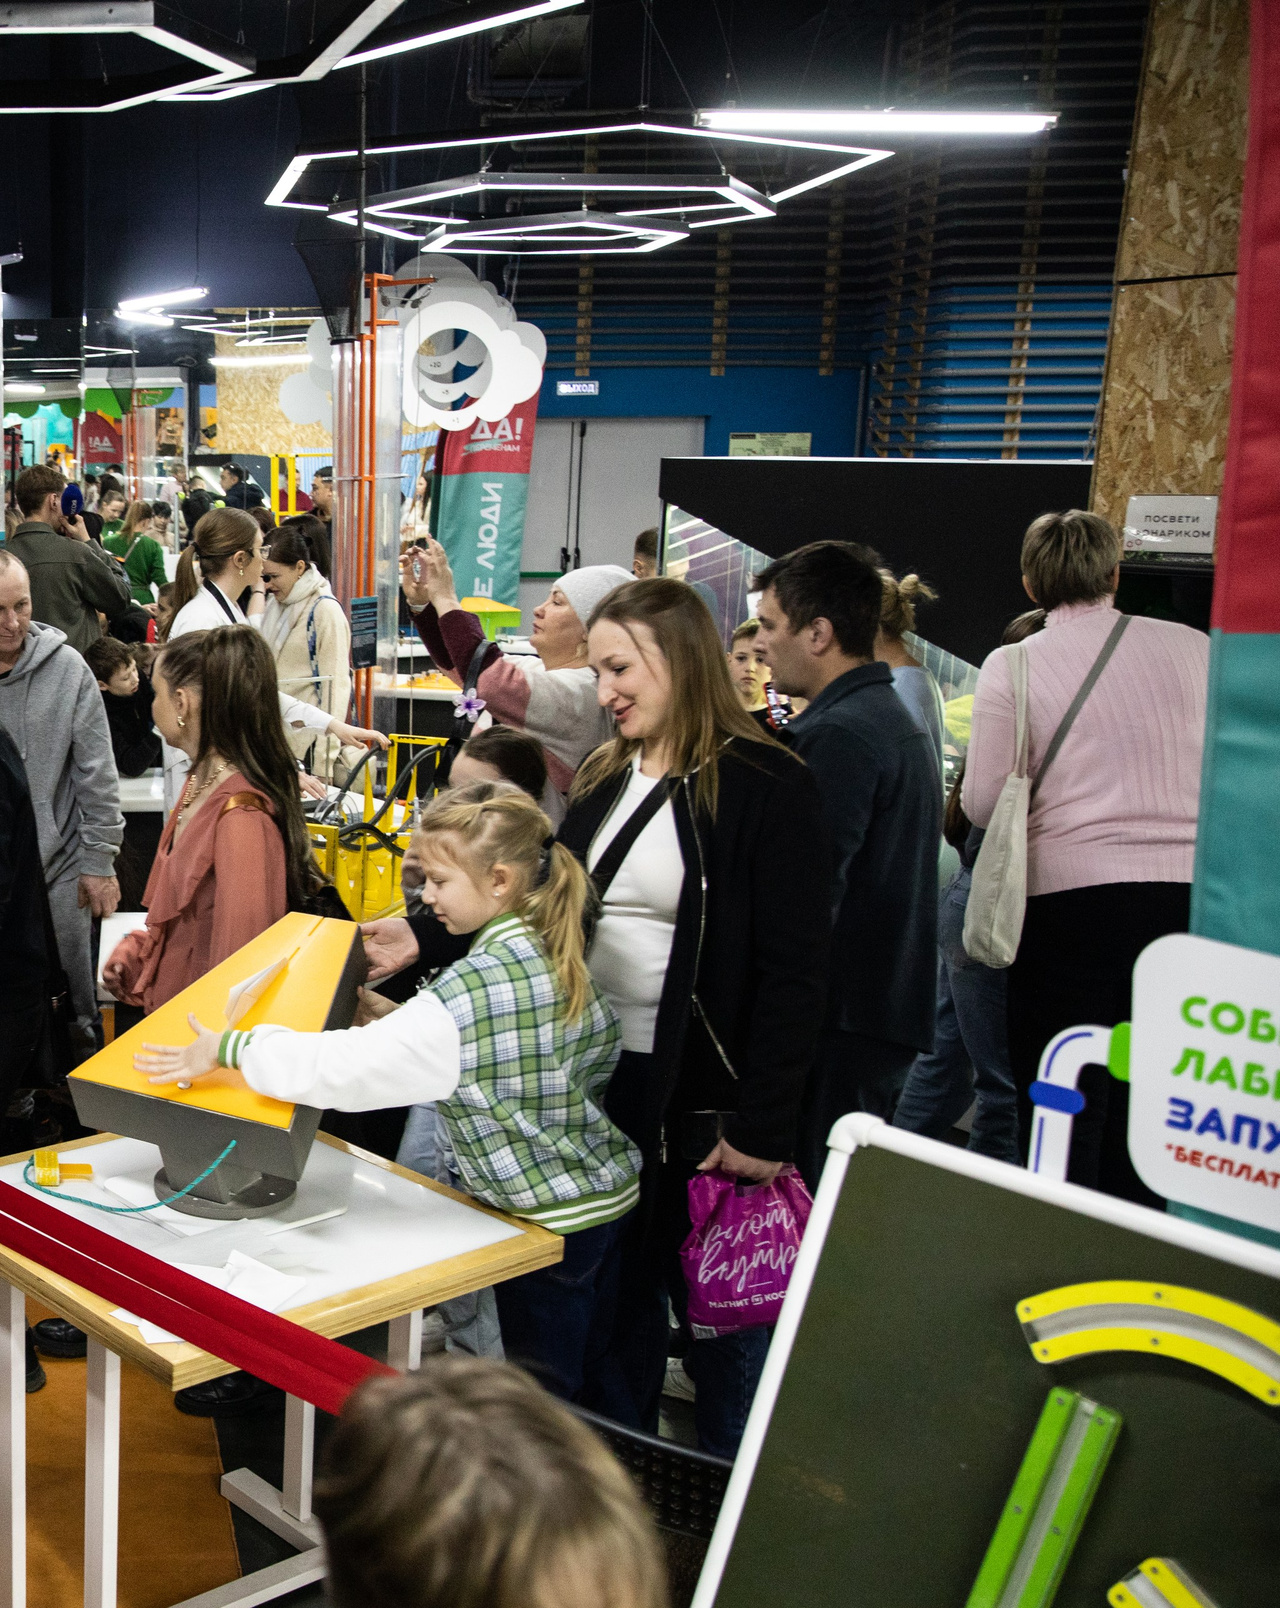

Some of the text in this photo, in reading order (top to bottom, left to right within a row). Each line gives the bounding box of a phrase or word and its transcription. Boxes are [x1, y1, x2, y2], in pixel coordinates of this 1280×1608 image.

[470, 417, 524, 441] ДА!
[476, 482, 504, 571] ЛЮДИ
[1136, 529, 1211, 538] ОНАРИКОМ
[1144, 515, 1200, 523] ПОСВЕТИ
[1180, 995, 1280, 1044] СОБ
[1171, 1047, 1280, 1101] ЛАБ
[698, 1241, 800, 1292] внутр
[708, 1290, 787, 1309] МАГНИТ КОС
